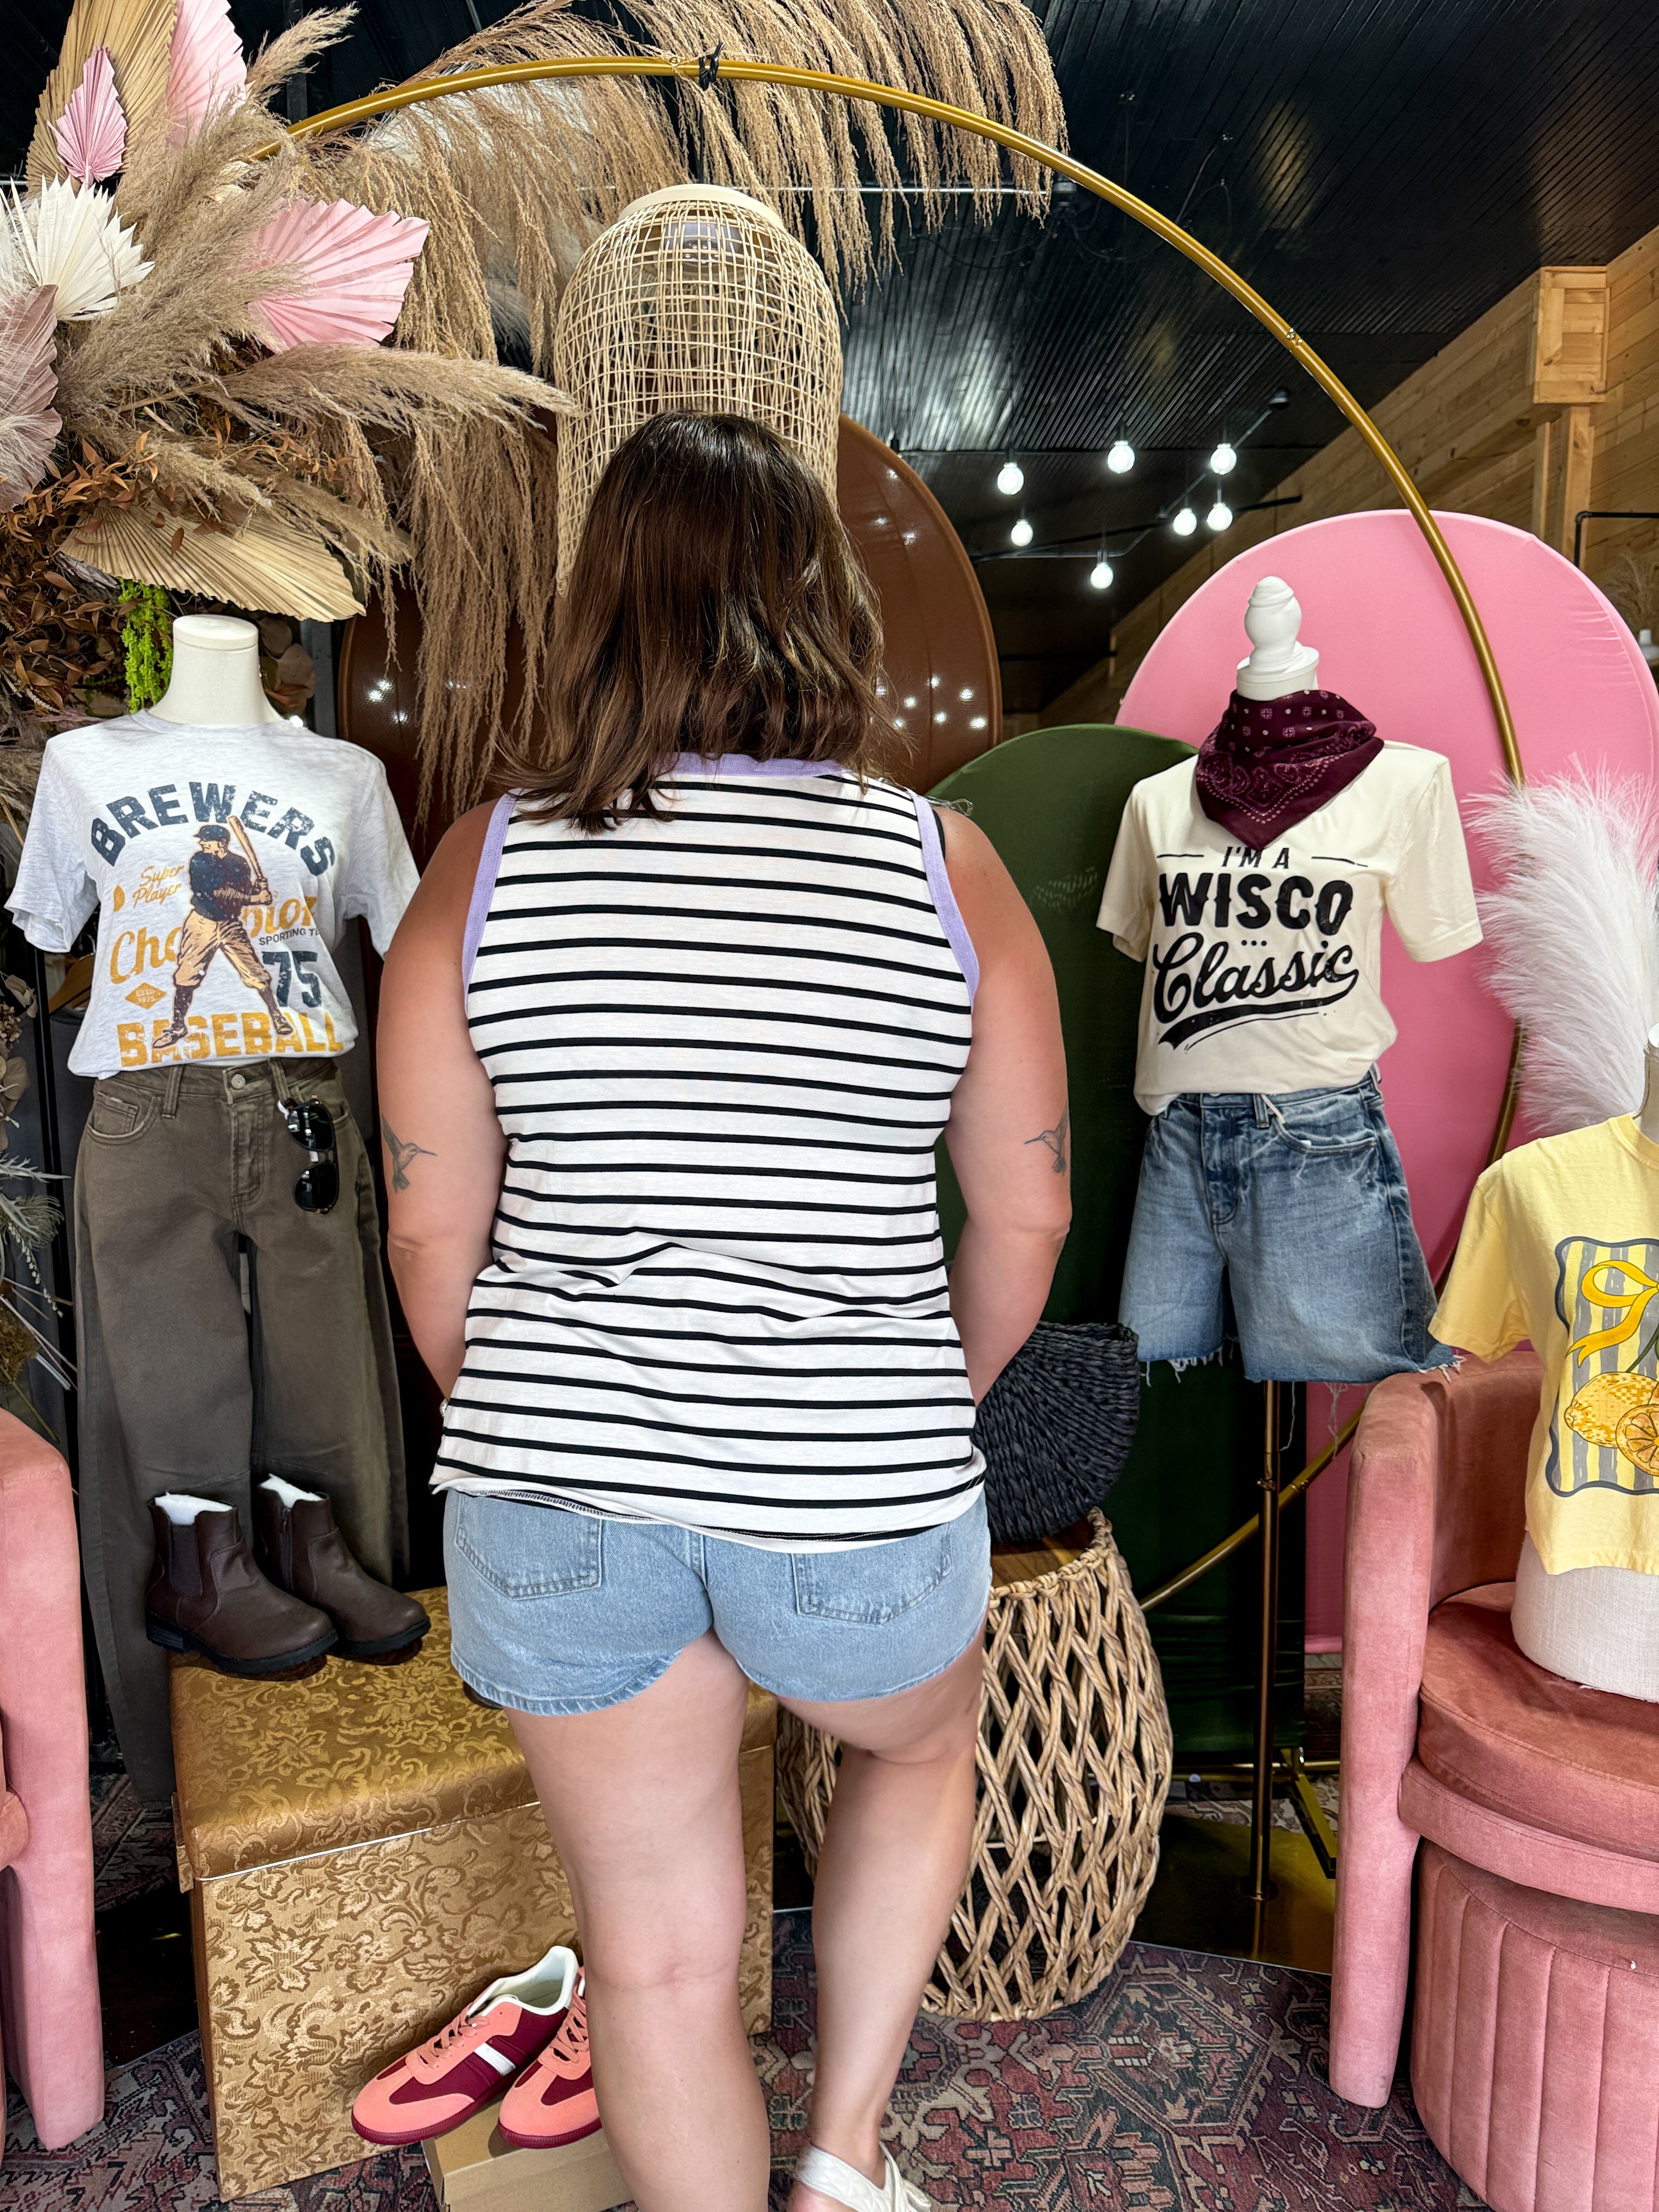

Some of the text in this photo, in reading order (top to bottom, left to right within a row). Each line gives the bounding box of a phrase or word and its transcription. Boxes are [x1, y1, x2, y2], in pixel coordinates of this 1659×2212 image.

[91, 782, 335, 876] BREWERS
[139, 865, 184, 888] Super
[1221, 847, 1290, 869] I'M A
[132, 883, 182, 909] Player
[1159, 872, 1353, 935] WISCO
[259, 928, 306, 945] SPORTING
[261, 951, 322, 1007] 75
[1153, 932, 1359, 1024] Classic
[117, 1012, 344, 1067] BASEBALL
